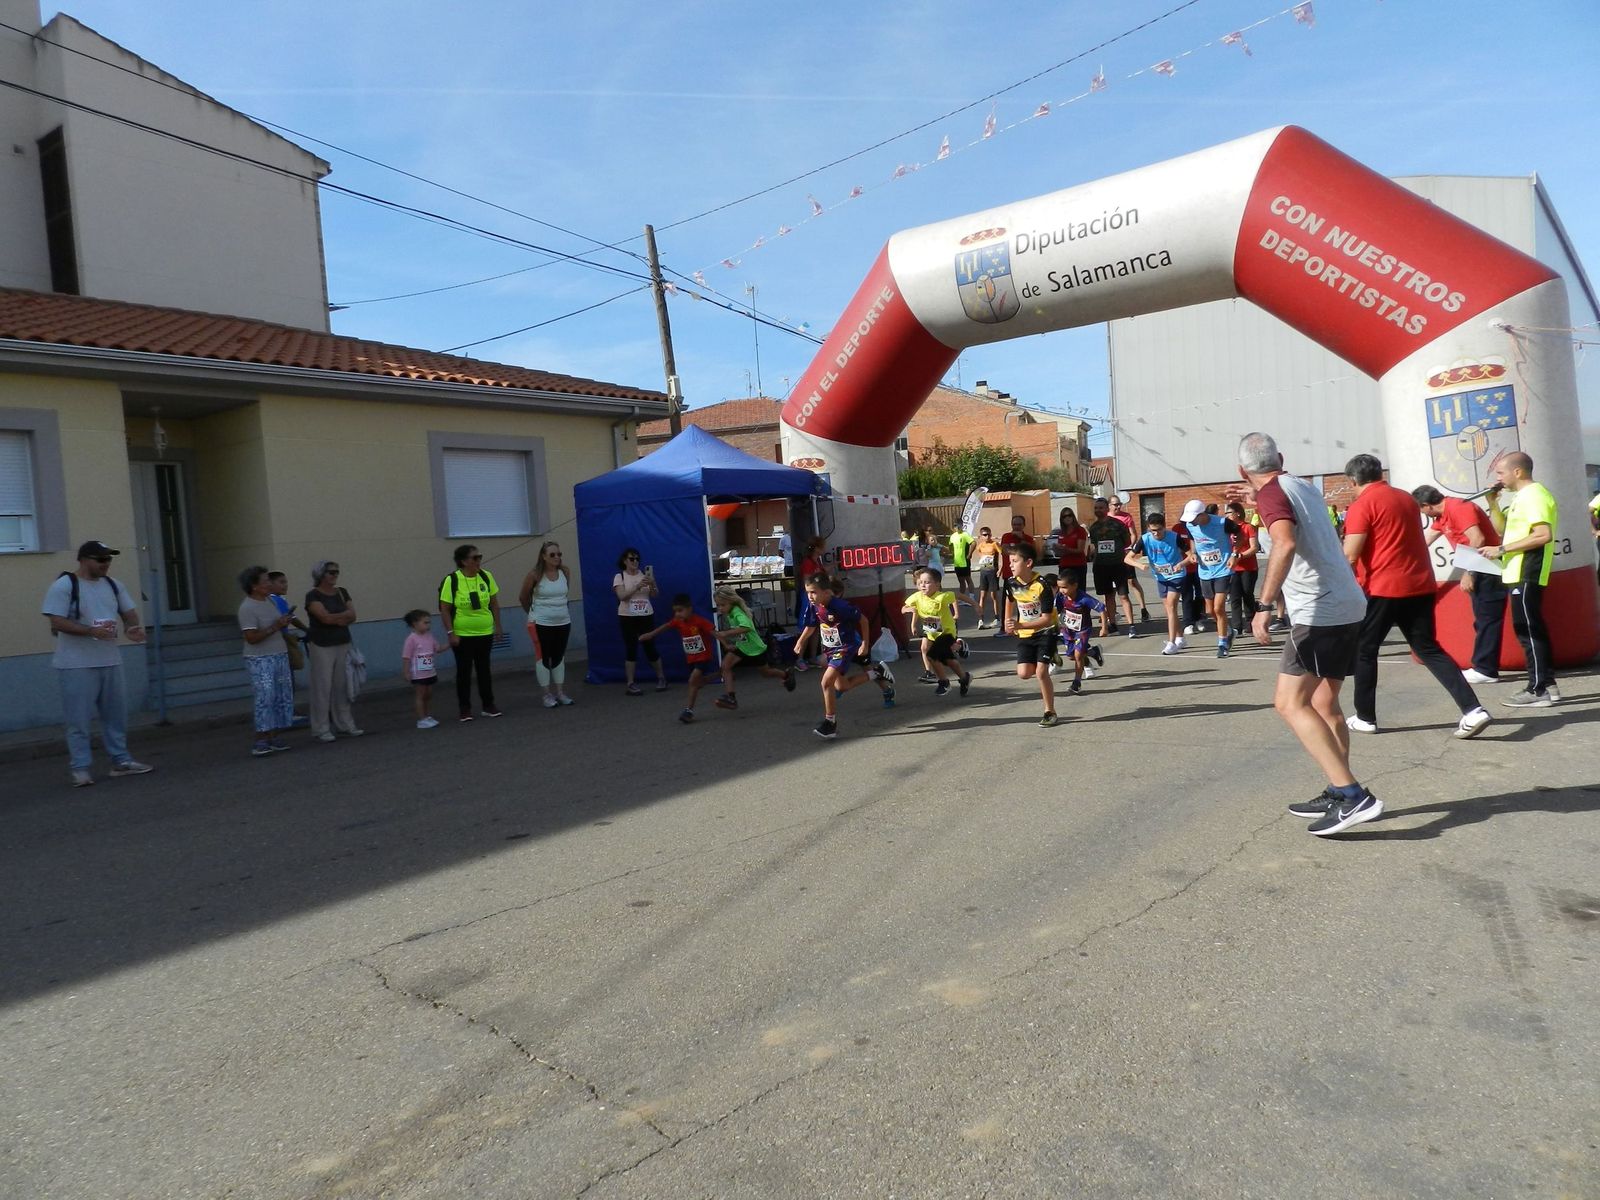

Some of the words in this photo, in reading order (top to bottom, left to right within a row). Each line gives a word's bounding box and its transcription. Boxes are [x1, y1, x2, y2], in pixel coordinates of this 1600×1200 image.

[1015, 206, 1139, 255] Diputación
[1269, 195, 1326, 236] CON
[1322, 225, 1466, 313] NUESTROS
[1021, 282, 1042, 299] de
[1047, 249, 1173, 293] Salamanca
[1258, 228, 1428, 336] DEPORTISTAS
[794, 390, 823, 428] CON
[819, 370, 839, 393] EL
[834, 285, 895, 369] DEPORTE
[1022, 608, 1039, 617] 546
